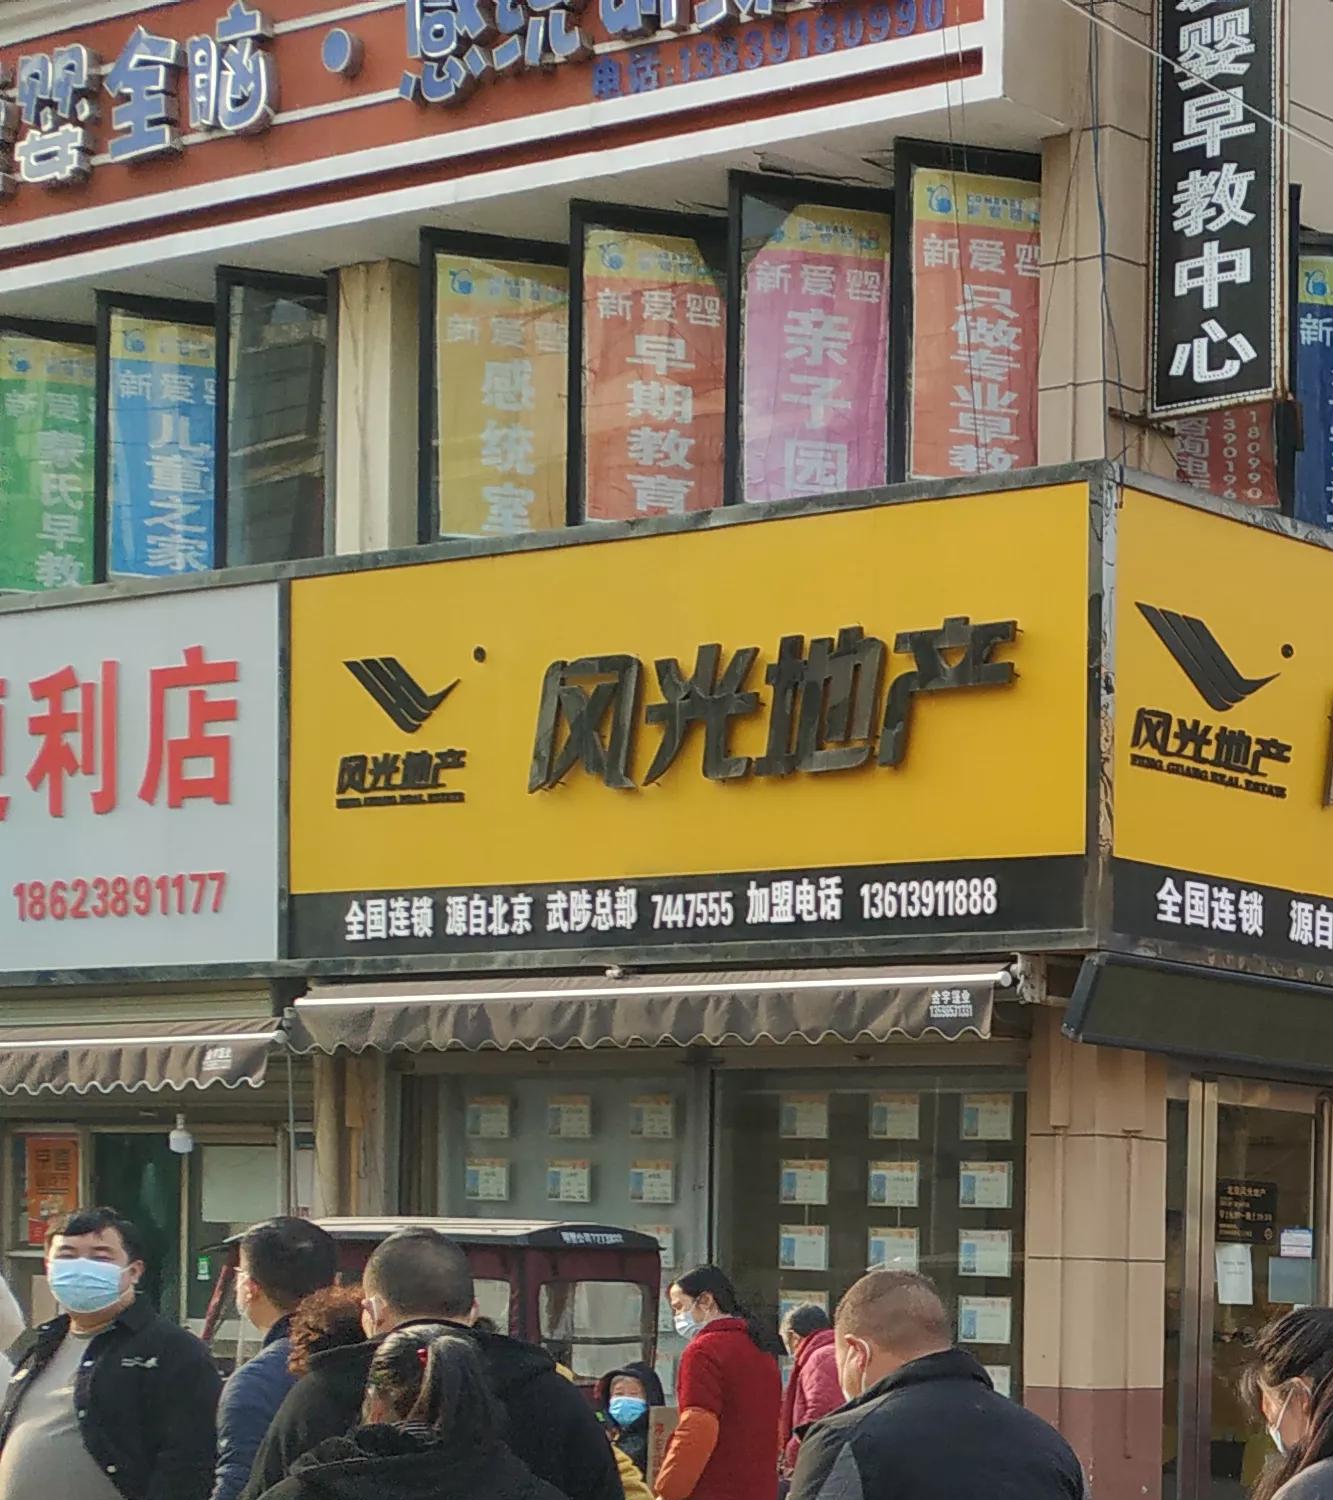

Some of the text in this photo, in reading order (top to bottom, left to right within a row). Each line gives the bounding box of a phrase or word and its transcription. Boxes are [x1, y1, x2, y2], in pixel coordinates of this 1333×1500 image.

[1169, 0, 1257, 384] 婴早教中心
[626, 334, 697, 514] 早期教育
[782, 307, 854, 493] 亲子园
[0, 643, 240, 822] 利店
[527, 614, 1022, 797] 风光地产
[1130, 707, 1293, 777] 风光地产
[336, 748, 467, 795] 风光地产
[12, 870, 227, 922] 18623891177
[344, 875, 999, 941] 全国连锁 源自北京 武陟总部 7447555 加盟电话 13613911888
[1156, 877, 1264, 938] 全国连锁
